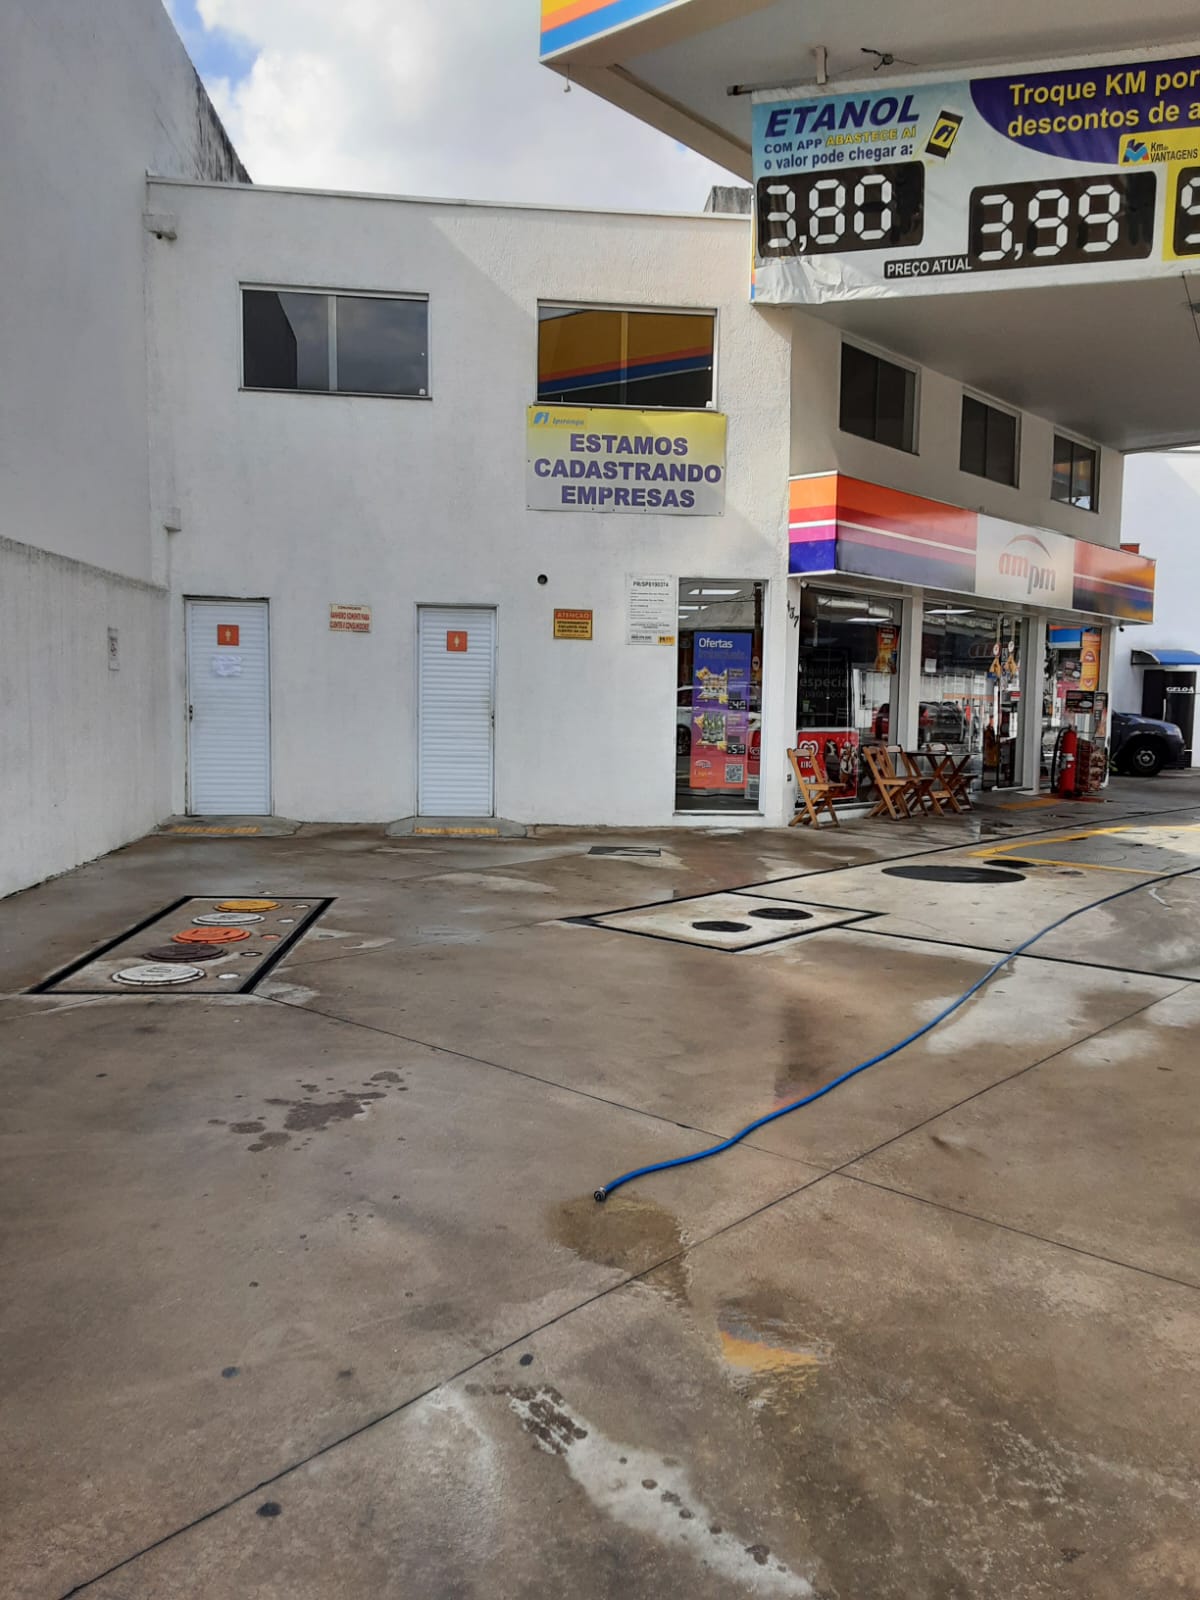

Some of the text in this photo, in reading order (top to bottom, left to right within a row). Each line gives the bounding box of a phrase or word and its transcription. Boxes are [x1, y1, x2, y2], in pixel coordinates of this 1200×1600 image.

[1009, 69, 1200, 106] Troque KM por
[764, 95, 920, 138] ETANOL
[1007, 108, 1139, 138] descontos
[1148, 100, 1180, 124] de
[764, 142, 792, 154] COM
[797, 138, 822, 150] APP
[825, 128, 897, 147] ABASTECE
[764, 144, 913, 170] o valor pode chegar a:
[1150, 148, 1198, 163] VANTAGENS
[766, 174, 892, 252] 3,80
[978, 184, 1121, 261] 3,99
[887, 256, 973, 277] PREÇO ATUAL
[570, 433, 688, 456] ESTAMOS
[534, 458, 722, 483] CADASTRANDO
[561, 485, 695, 508] EMPRESAS
[699, 637, 733, 649] Ofertas
[800, 676, 848, 690] especia
